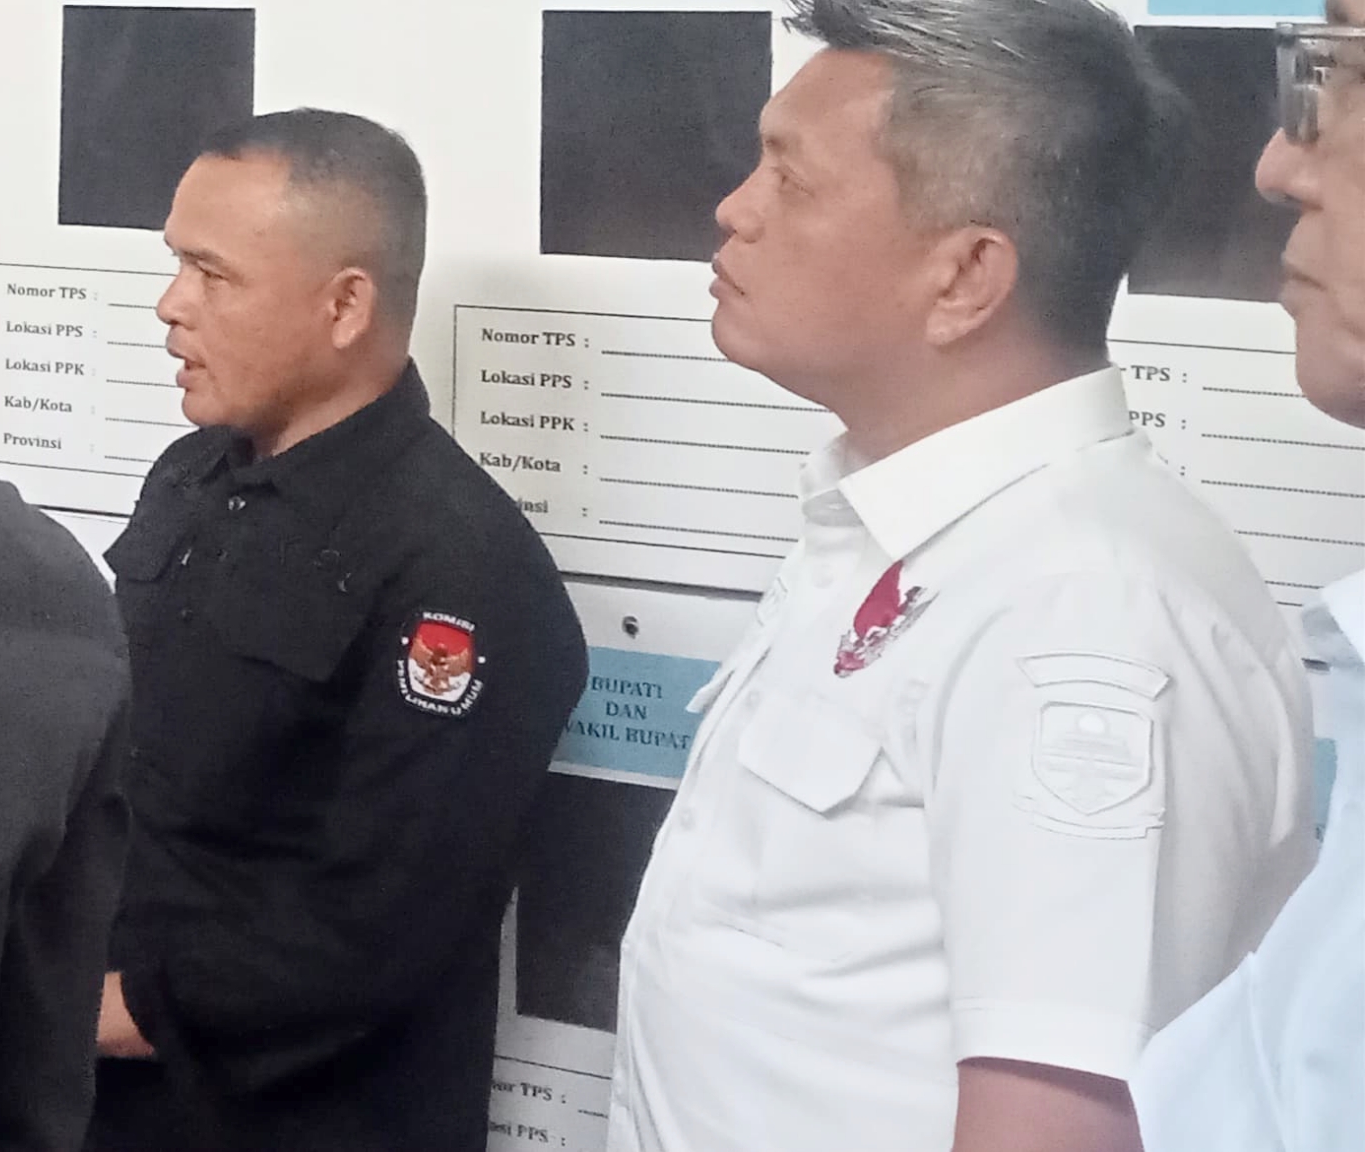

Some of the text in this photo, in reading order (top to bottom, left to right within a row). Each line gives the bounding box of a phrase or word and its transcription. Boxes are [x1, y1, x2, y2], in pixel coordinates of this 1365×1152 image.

[7, 284, 86, 299] Nomor TPS
[6, 321, 83, 337] Lokasi PPS
[482, 328, 575, 346] Nomor TPS
[6, 358, 84, 375] Lokasi PPK
[1131, 365, 1170, 381] TPS
[482, 370, 571, 388] Lokasi PPS
[5, 396, 72, 412] Kab/Kota
[481, 411, 574, 431] Lokasi PPK
[1129, 411, 1165, 428] PPS
[4, 433, 61, 449] Provinsi
[480, 452, 560, 472] Kab/Kota
[591, 676, 662, 698] BUPATI
[606, 701, 646, 719] DAN
[626, 727, 690, 749] BUPAT
[520, 1083, 552, 1101] TPS
